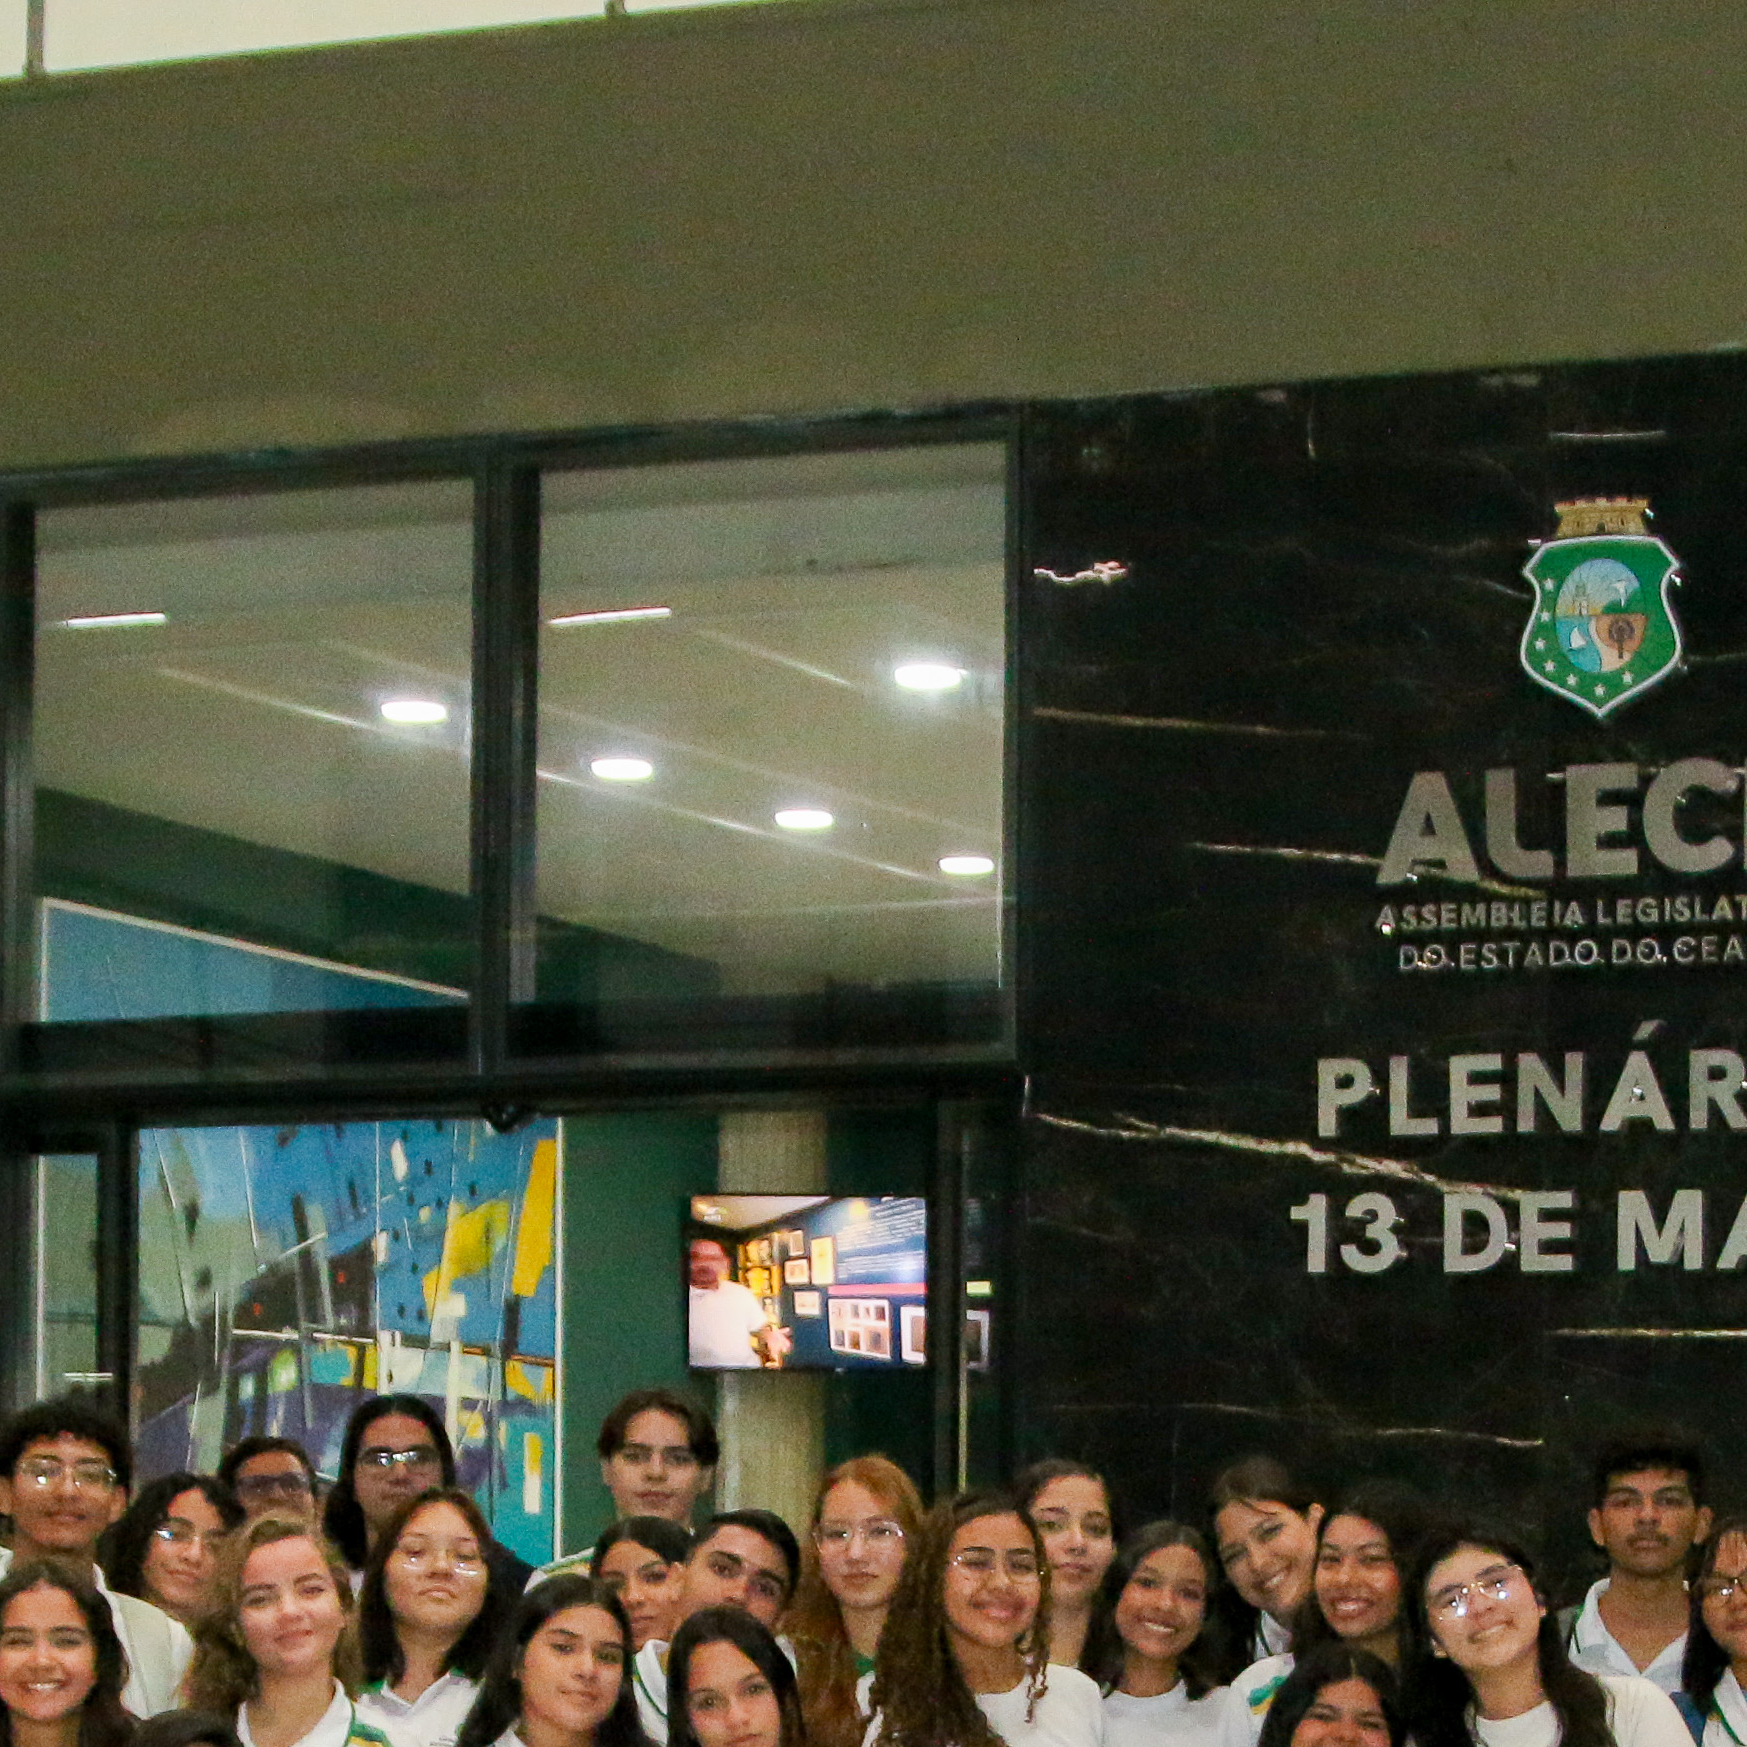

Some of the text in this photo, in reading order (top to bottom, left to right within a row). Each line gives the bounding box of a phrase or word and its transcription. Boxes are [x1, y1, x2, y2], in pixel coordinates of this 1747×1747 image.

[1374, 899, 1585, 929] ASSEMBLEIA
[1399, 944, 1446, 970] DO
[1459, 940, 1599, 969] ESTADO
[1611, 938, 1660, 964] DO
[1290, 1191, 1407, 1274] 13
[1443, 1190, 1573, 1273] DE
